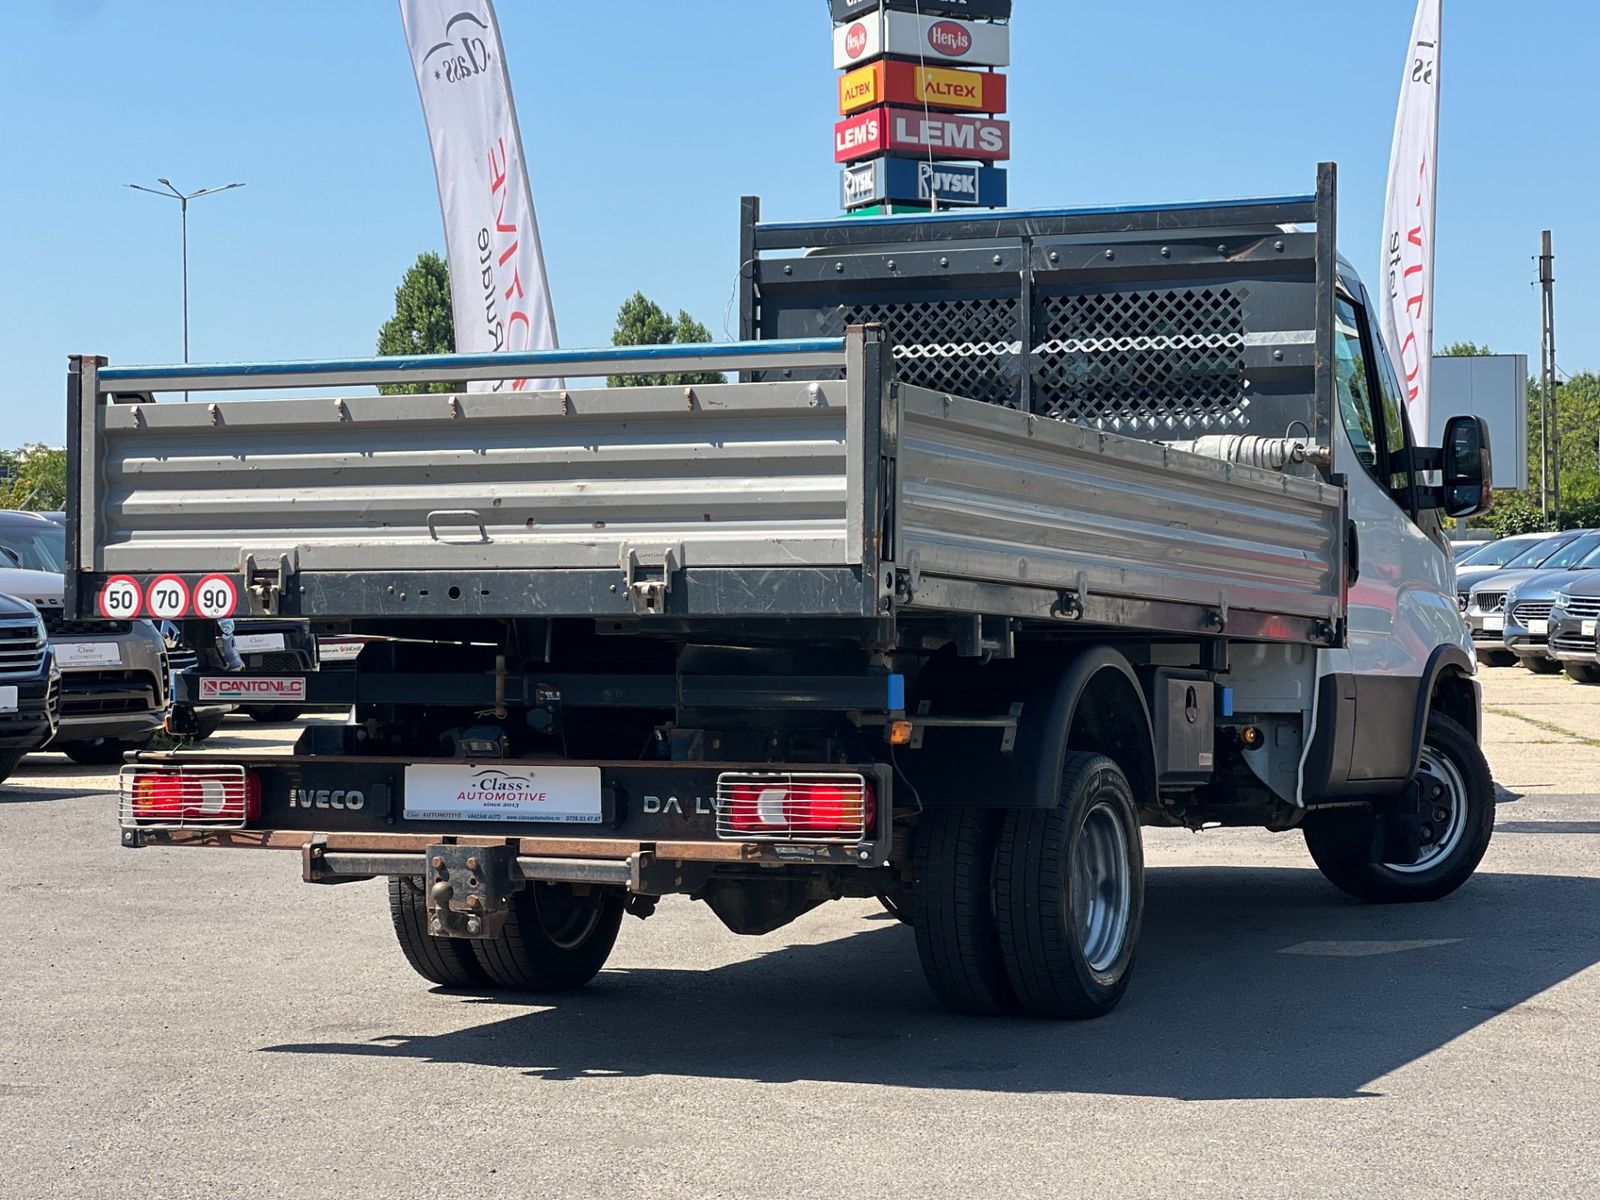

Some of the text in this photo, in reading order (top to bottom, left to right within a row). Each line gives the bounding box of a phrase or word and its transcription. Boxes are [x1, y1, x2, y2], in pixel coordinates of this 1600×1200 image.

[932, 27, 969, 50] Hervis
[836, 118, 878, 152] LEM'S
[896, 117, 1003, 152] LEM'S
[931, 171, 975, 193] JYSK
[109, 590, 133, 609] 50
[156, 590, 180, 609] 70
[203, 589, 227, 609] 90
[479, 778, 523, 791] Class
[289, 788, 365, 810] IVECO
[457, 791, 547, 802] AUTOMOTIVE
